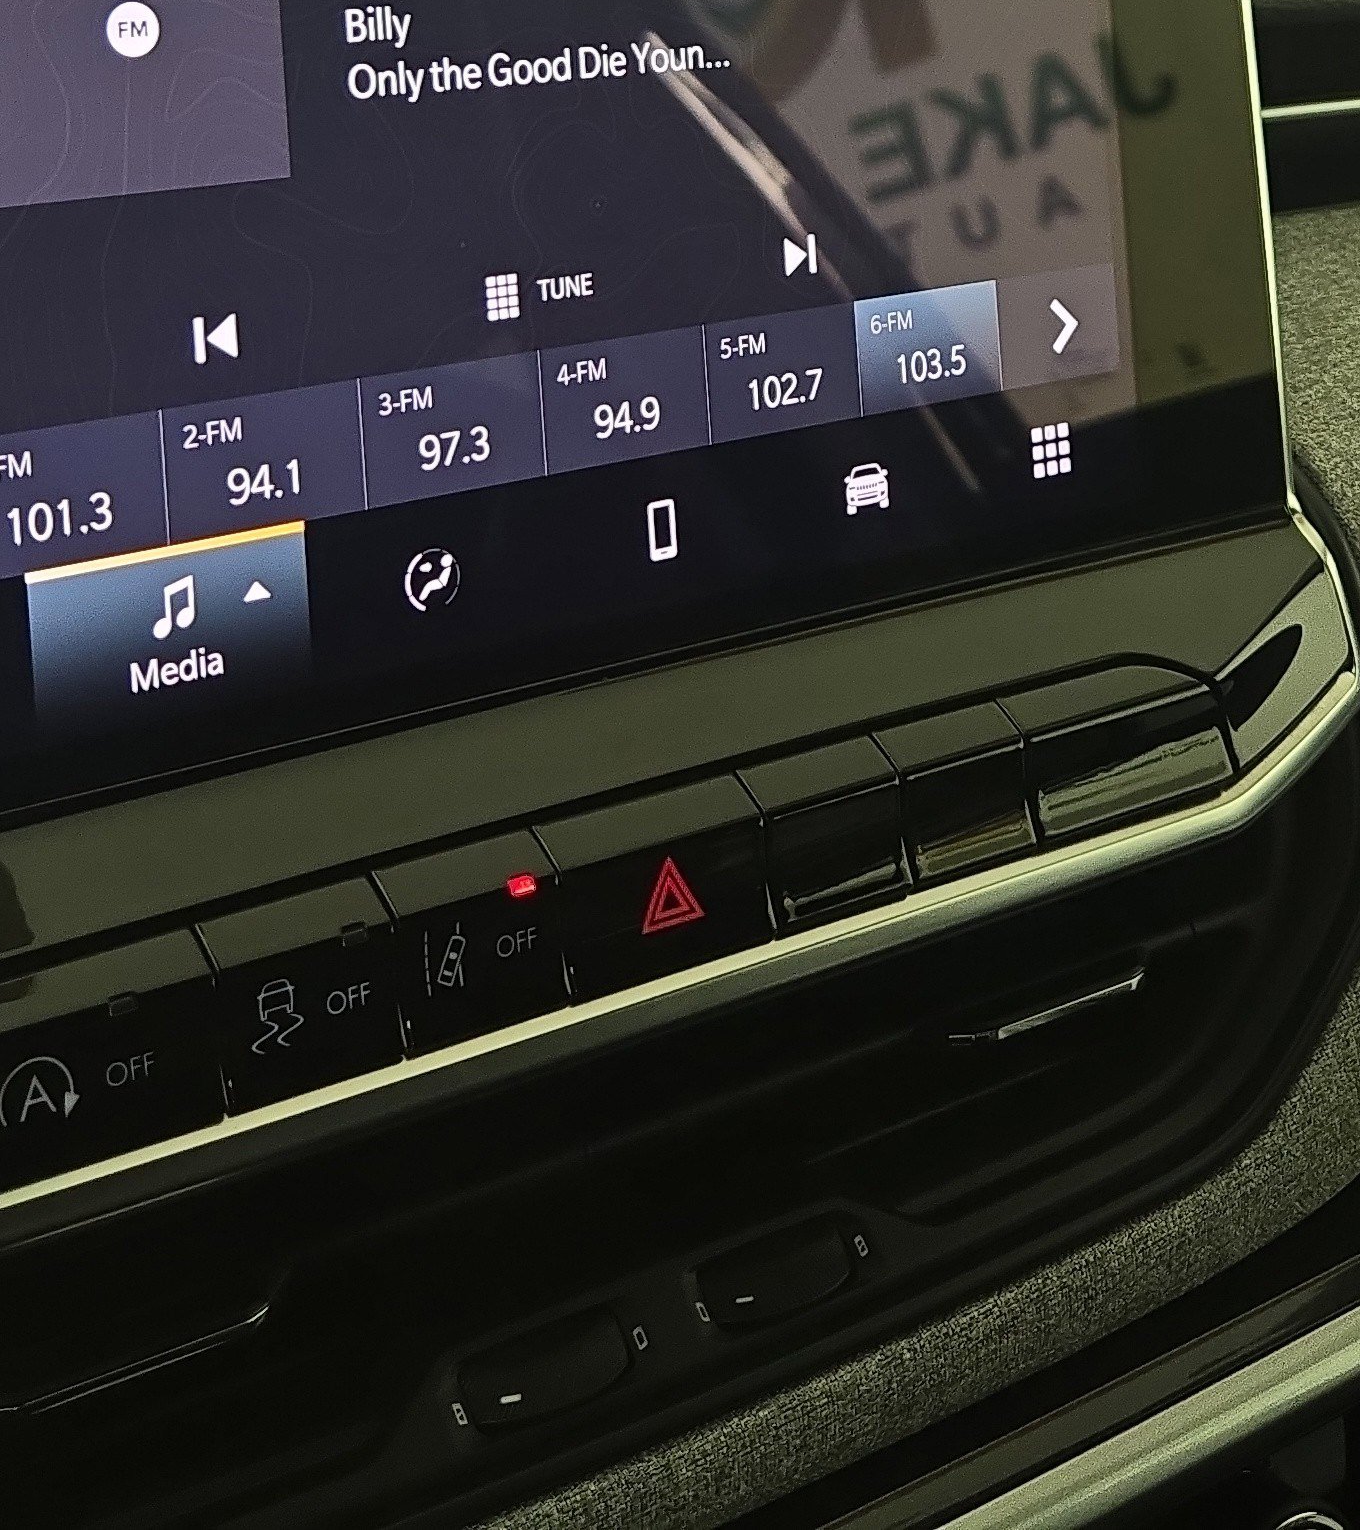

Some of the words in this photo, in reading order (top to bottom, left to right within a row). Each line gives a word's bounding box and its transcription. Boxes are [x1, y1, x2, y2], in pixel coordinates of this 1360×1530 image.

[118, 20, 147, 38] FM
[344, 5, 412, 48] Billy
[347, 59, 426, 104] Only
[428, 57, 483, 94] the
[487, 49, 572, 88] Good
[578, 43, 627, 80] Die
[629, 40, 732, 75] Youn...
[536, 272, 594, 302] TUNE
[870, 309, 913, 335] 6-FM
[720, 332, 766, 360] 5-FM
[896, 343, 967, 384] 103.5
[556, 357, 607, 386] 4-FM
[748, 368, 823, 411] 102.7
[378, 385, 433, 416] 3-FM
[593, 396, 661, 439] 94.9
[182, 416, 243, 450] 2-FM
[418, 425, 490, 471] 97.3
[226, 458, 300, 506] 94.1
[7, 491, 113, 546] 101.3
[129, 646, 225, 694] Media
[496, 926, 537, 958] OFF
[326, 981, 371, 1015] OFF
[105, 1051, 154, 1087] OFF
